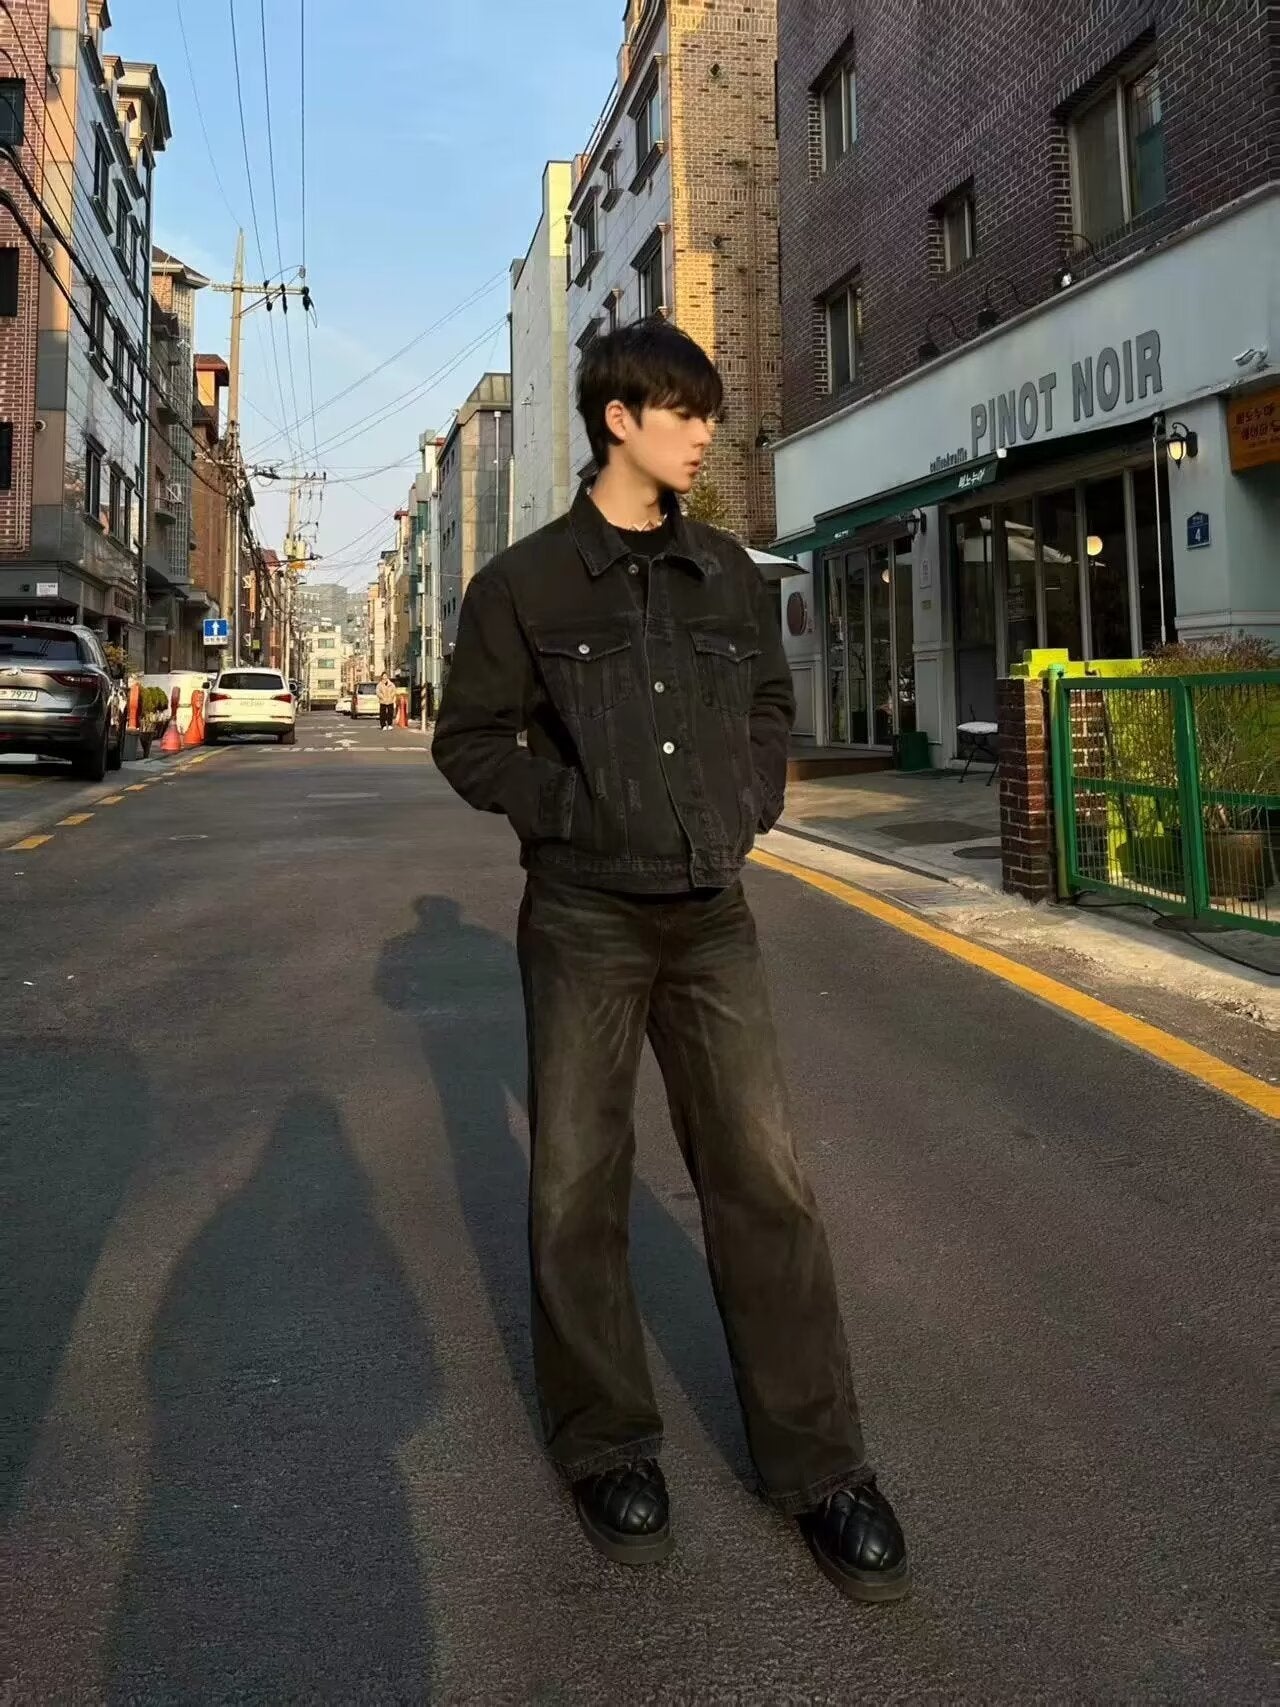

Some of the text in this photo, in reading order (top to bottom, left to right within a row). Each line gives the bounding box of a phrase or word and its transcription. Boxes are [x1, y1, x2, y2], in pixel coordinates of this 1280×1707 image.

[970, 329, 1163, 458] PINOT NOIR
[1194, 527, 1201, 542] 4
[10, 690, 34, 698] 7977
